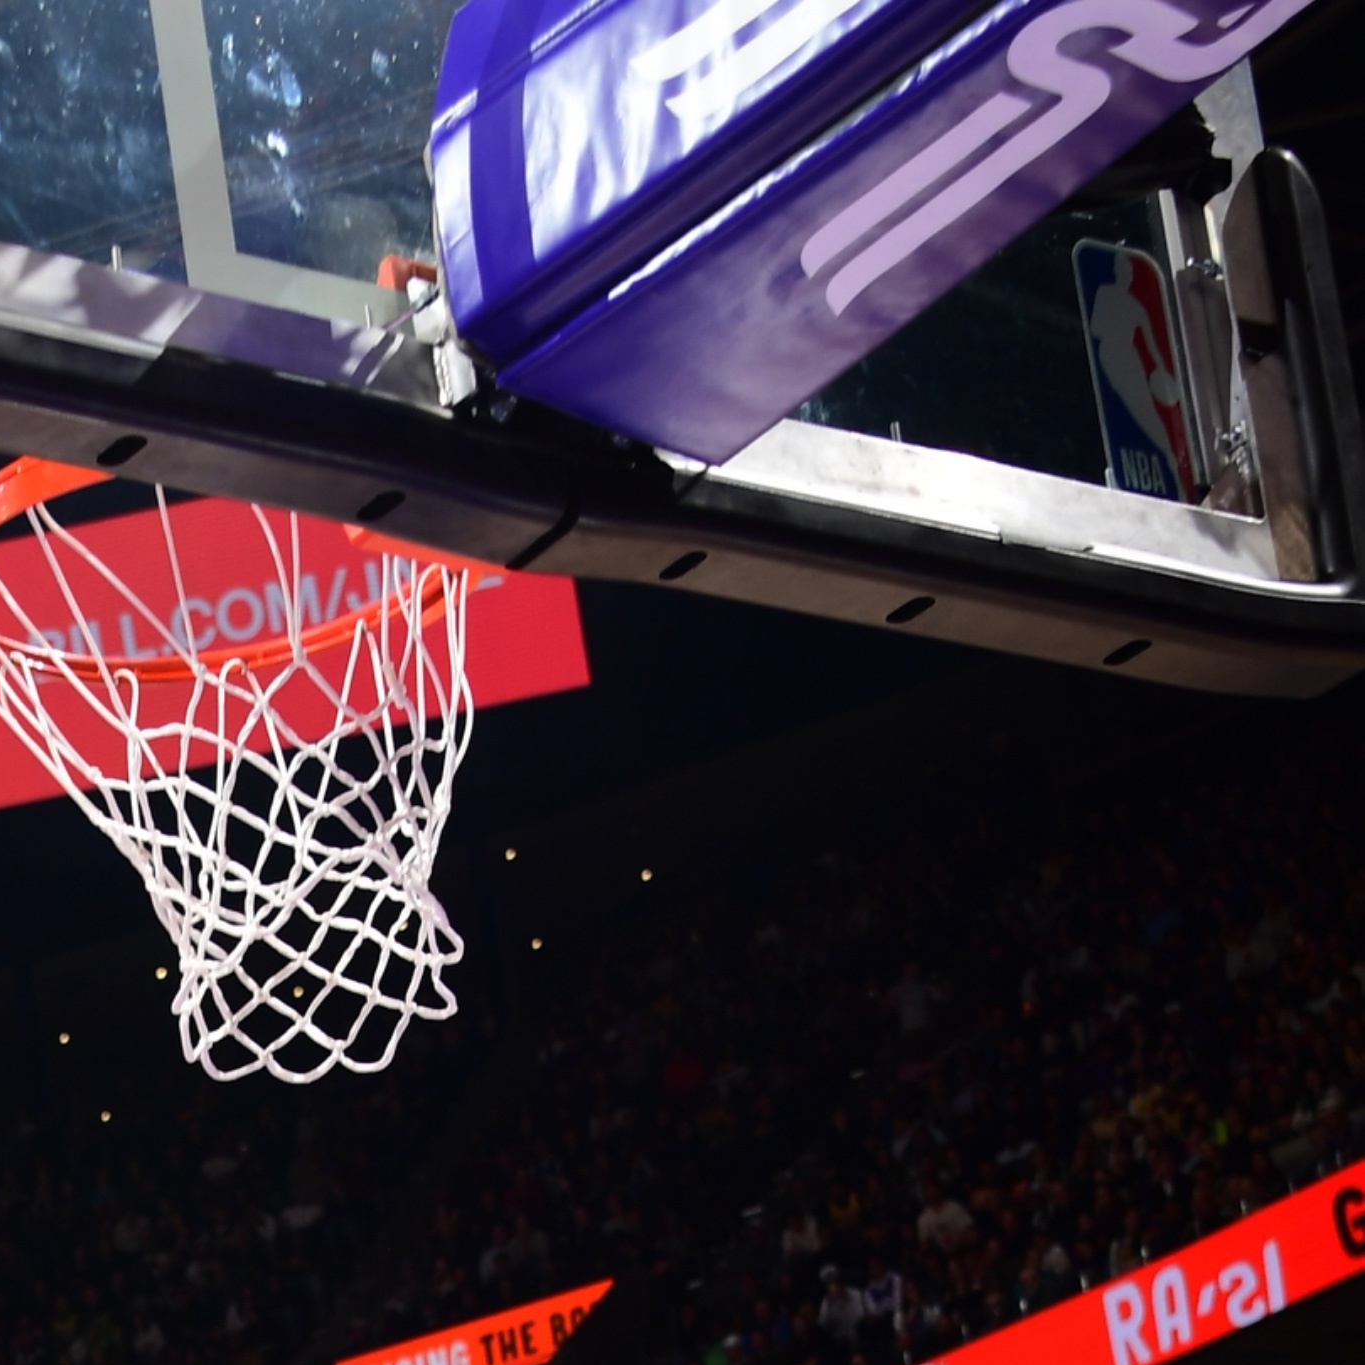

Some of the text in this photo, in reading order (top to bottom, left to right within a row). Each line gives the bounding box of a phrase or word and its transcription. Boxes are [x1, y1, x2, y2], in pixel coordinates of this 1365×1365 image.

[1120, 447, 1167, 495] NBA
[1333, 1186, 1365, 1259] G
[549, 1306, 587, 1347] BA
